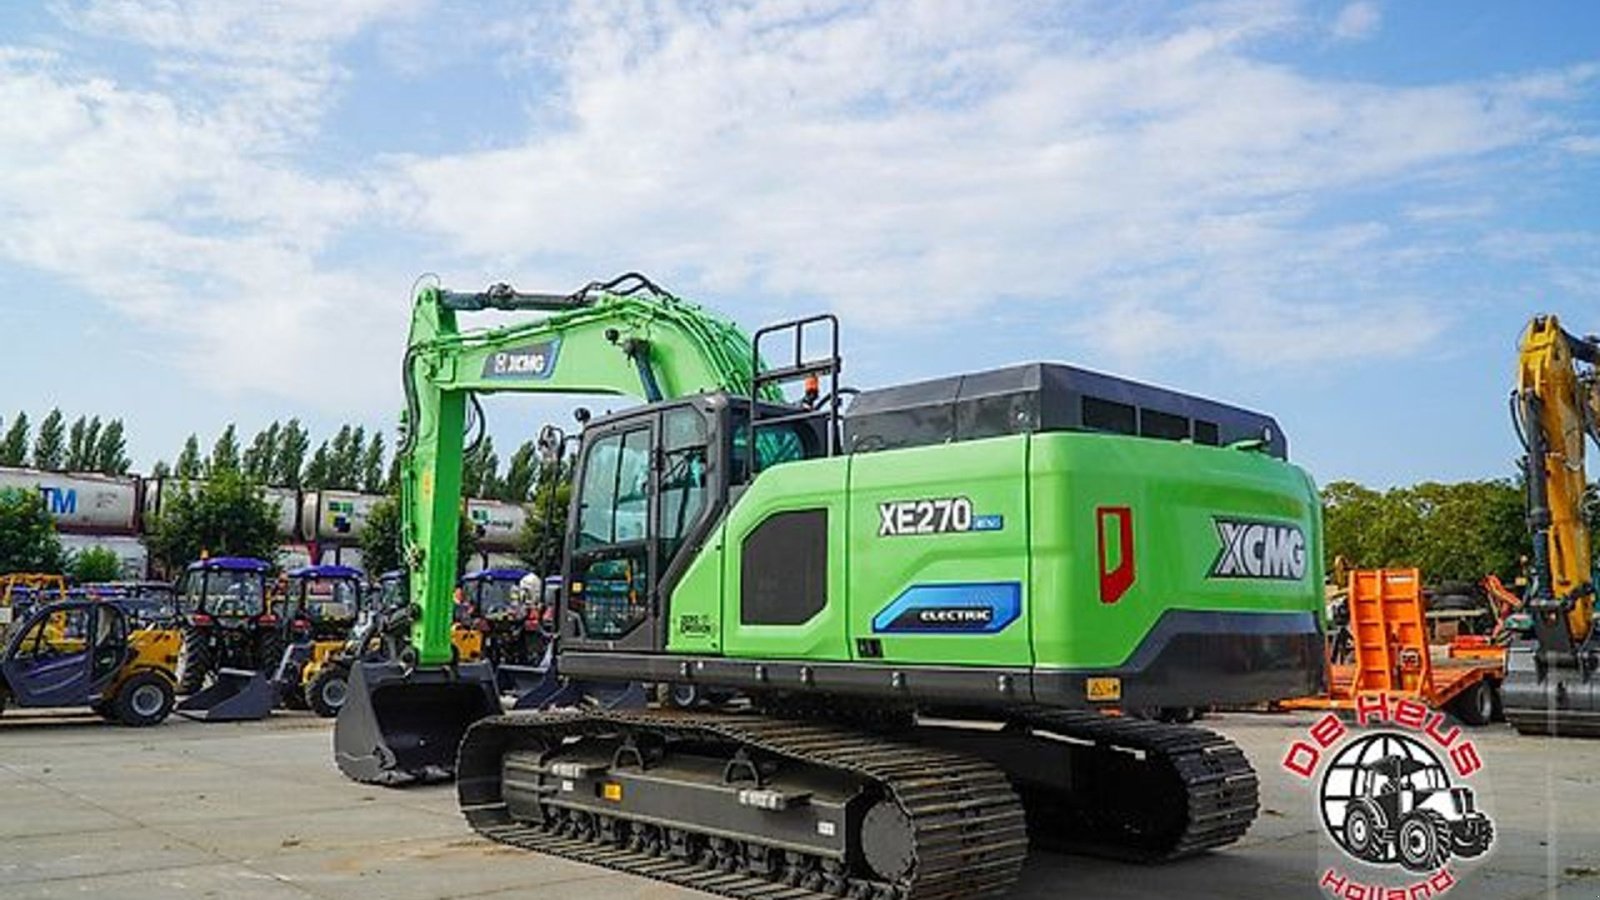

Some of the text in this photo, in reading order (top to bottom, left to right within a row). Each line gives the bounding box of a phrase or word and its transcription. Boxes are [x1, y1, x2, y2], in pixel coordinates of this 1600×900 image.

[506, 354, 545, 372] XCMG
[879, 498, 971, 535] XE270
[1212, 521, 1306, 578] XCMG
[920, 609, 991, 621] ELECTRIC
